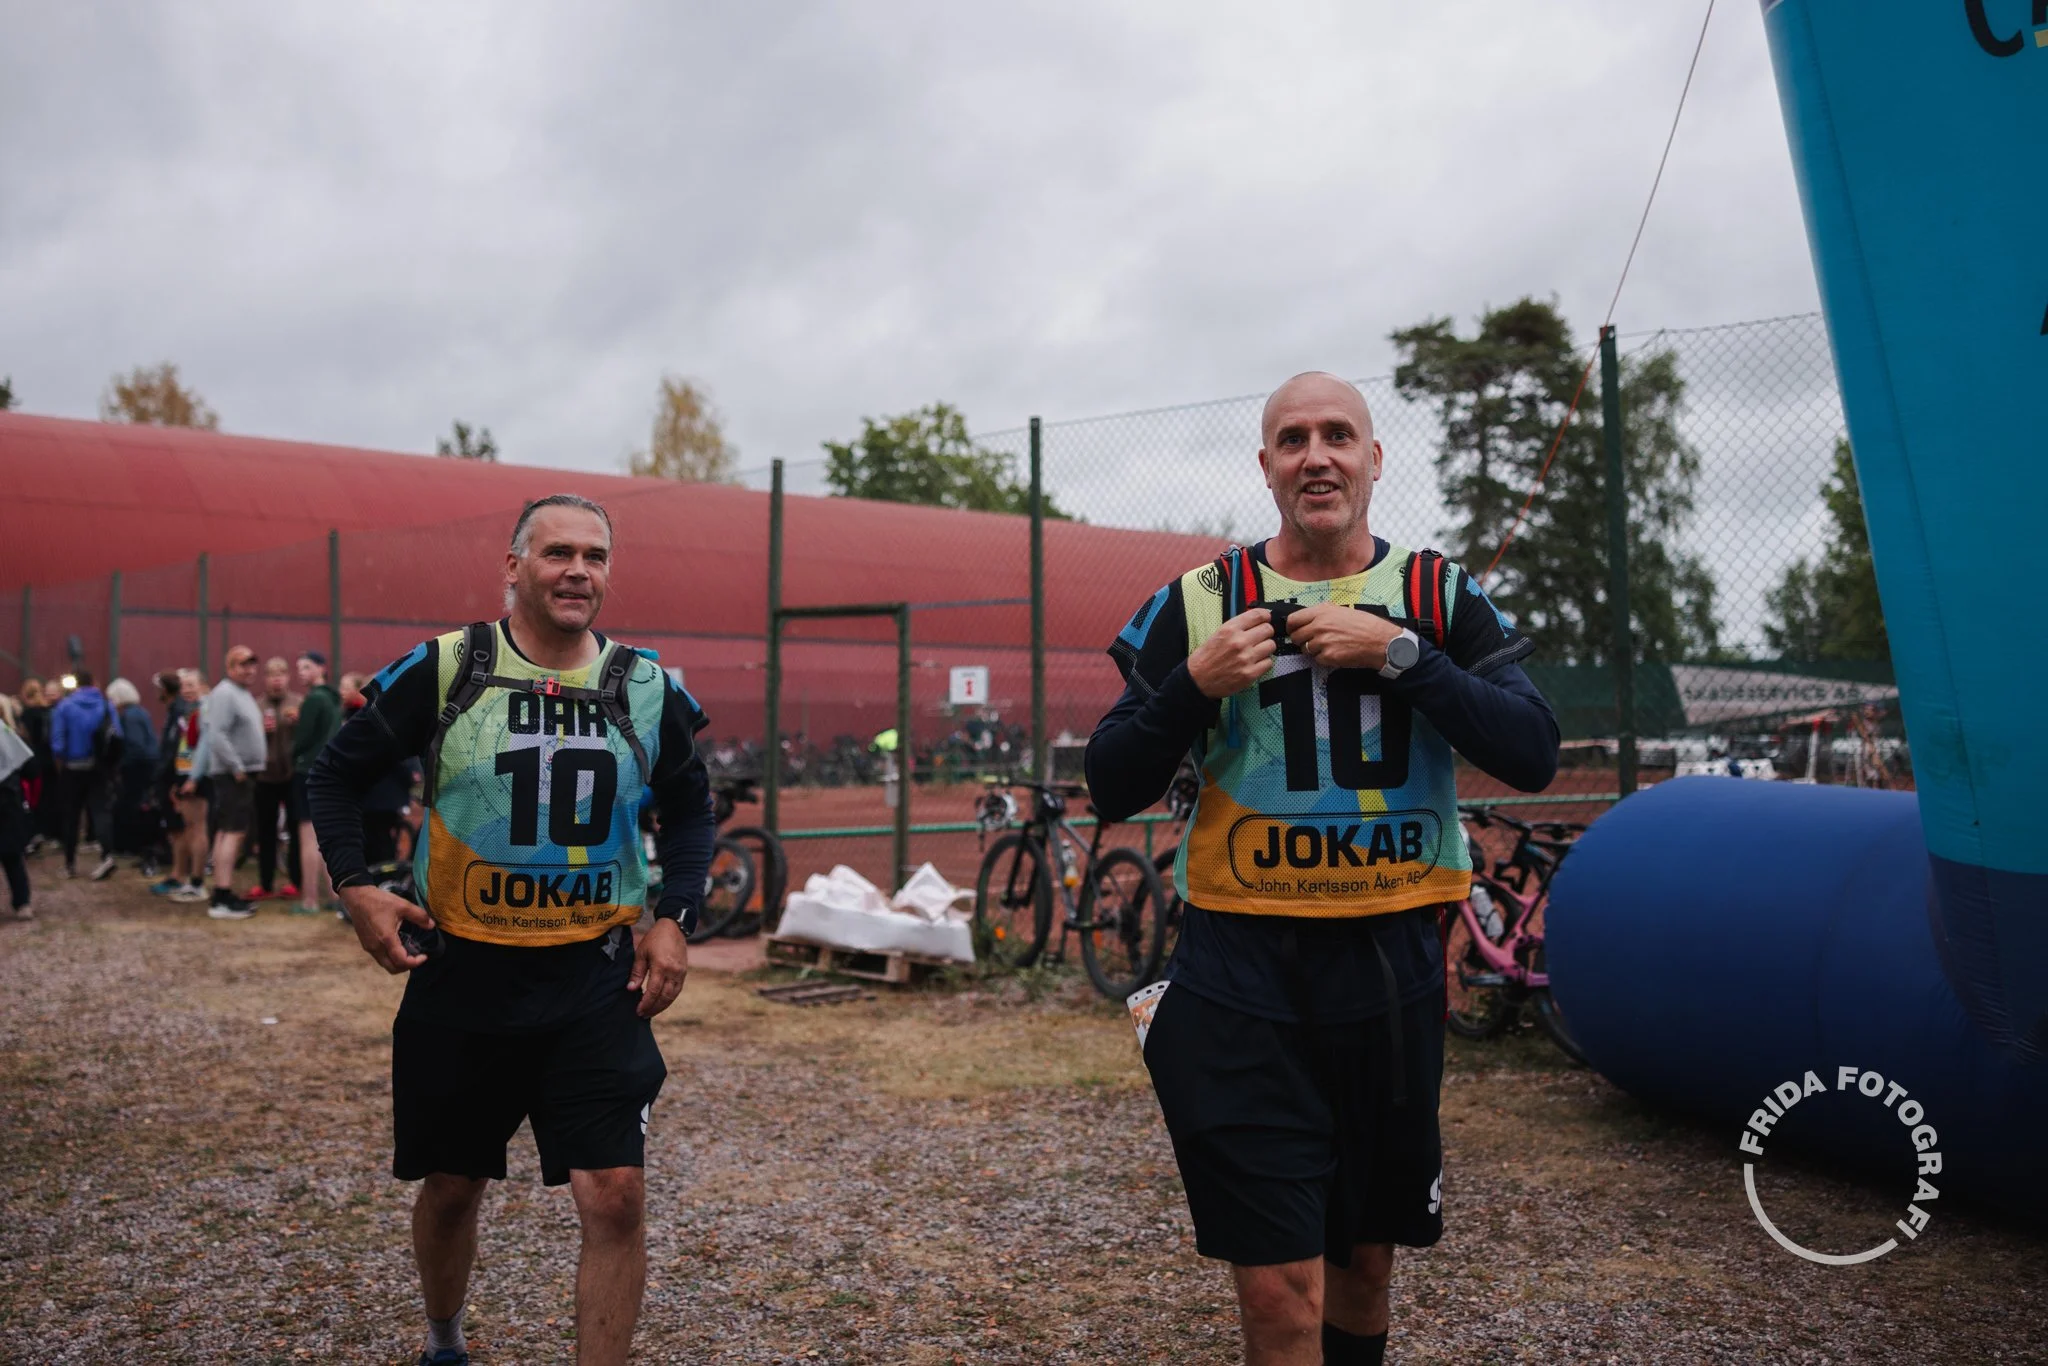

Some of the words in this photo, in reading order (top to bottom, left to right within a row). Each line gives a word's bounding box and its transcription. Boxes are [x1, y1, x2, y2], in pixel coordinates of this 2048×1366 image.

[1259, 667, 1413, 792] 10
[495, 745, 618, 847] 10
[1254, 821, 1423, 869] JOKAB
[480, 871, 612, 908] JOKAB
[1255, 878, 1291, 893] John
[1297, 879, 1369, 894] Karlsson
[1406, 871, 1422, 885] AB
[480, 912, 508, 926] John
[512, 915, 567, 929] Karlsson
[596, 910, 611, 923] AB
